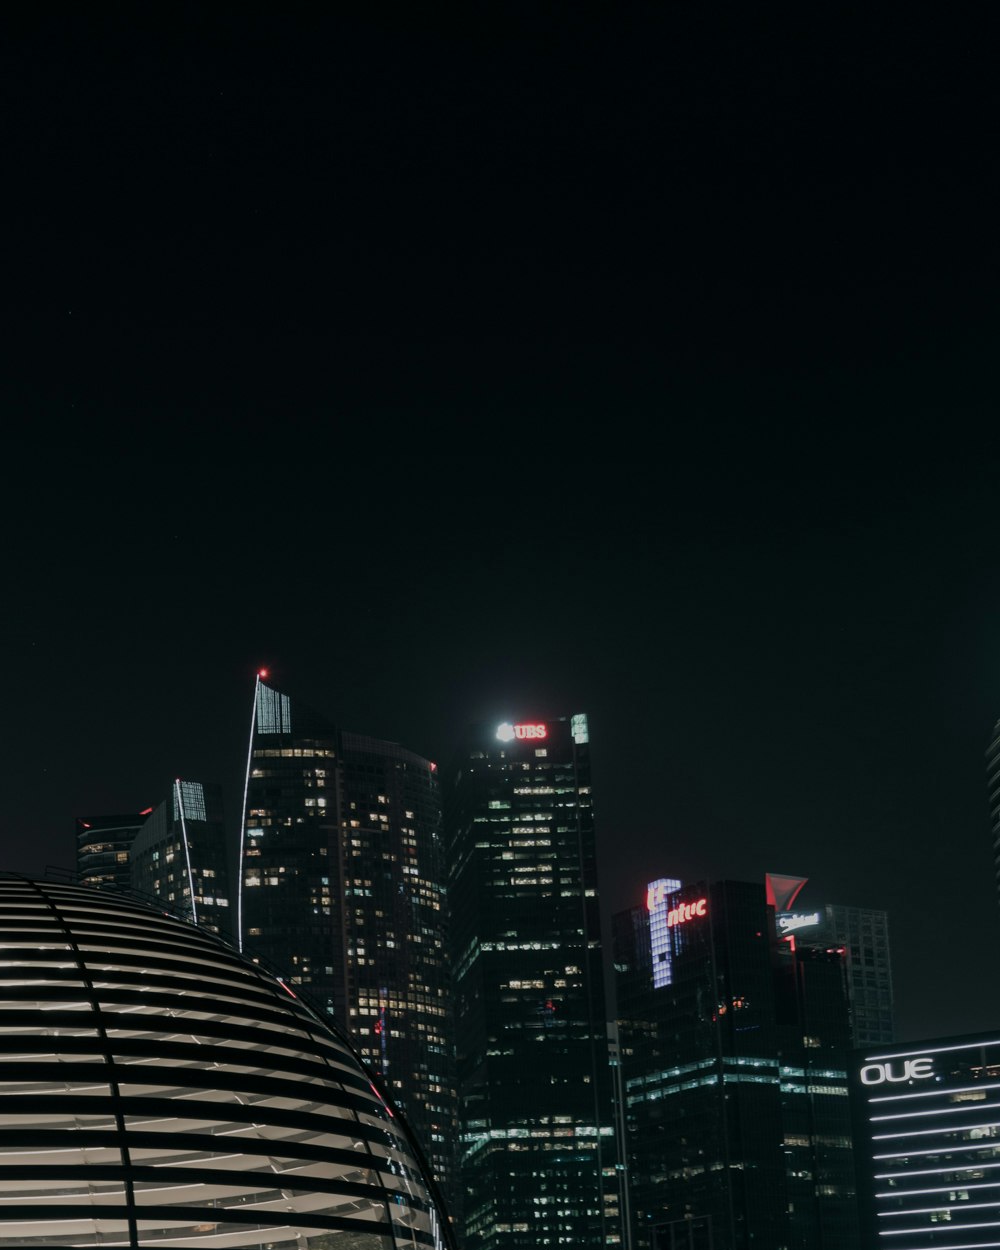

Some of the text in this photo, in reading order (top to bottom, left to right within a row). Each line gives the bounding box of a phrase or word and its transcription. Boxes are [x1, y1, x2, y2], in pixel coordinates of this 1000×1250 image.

[514, 725, 547, 739] UBS
[667, 899, 707, 927] ntuc
[860, 1058, 935, 1085] OUE
